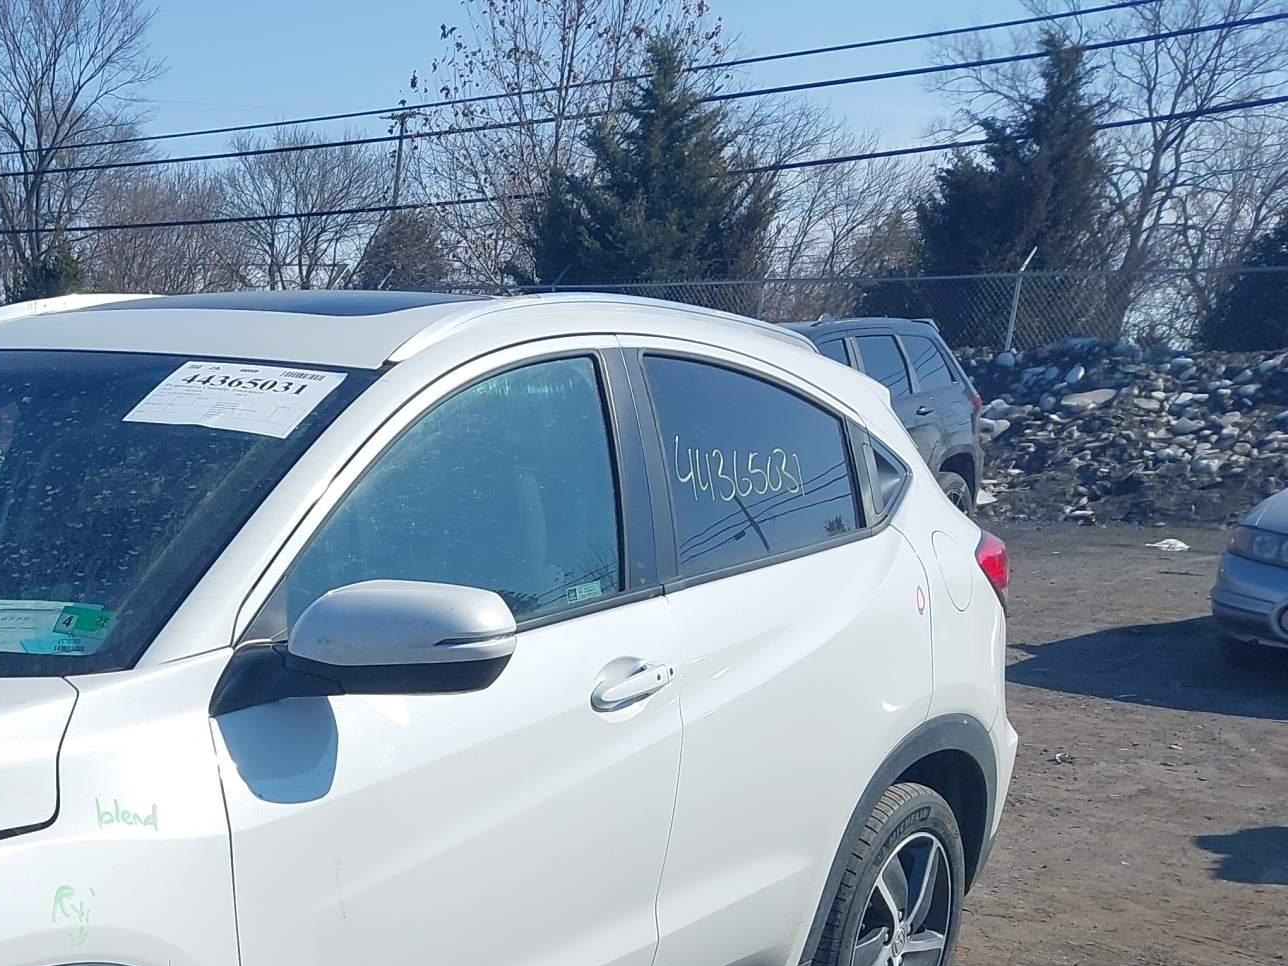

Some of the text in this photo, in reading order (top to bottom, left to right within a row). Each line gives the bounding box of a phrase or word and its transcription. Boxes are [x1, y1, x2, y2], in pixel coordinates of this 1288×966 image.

[182, 373, 309, 395] 44365031
[675, 435, 805, 501] 44365031
[62, 614, 73, 628] 4
[94, 796, 159, 832] blend
